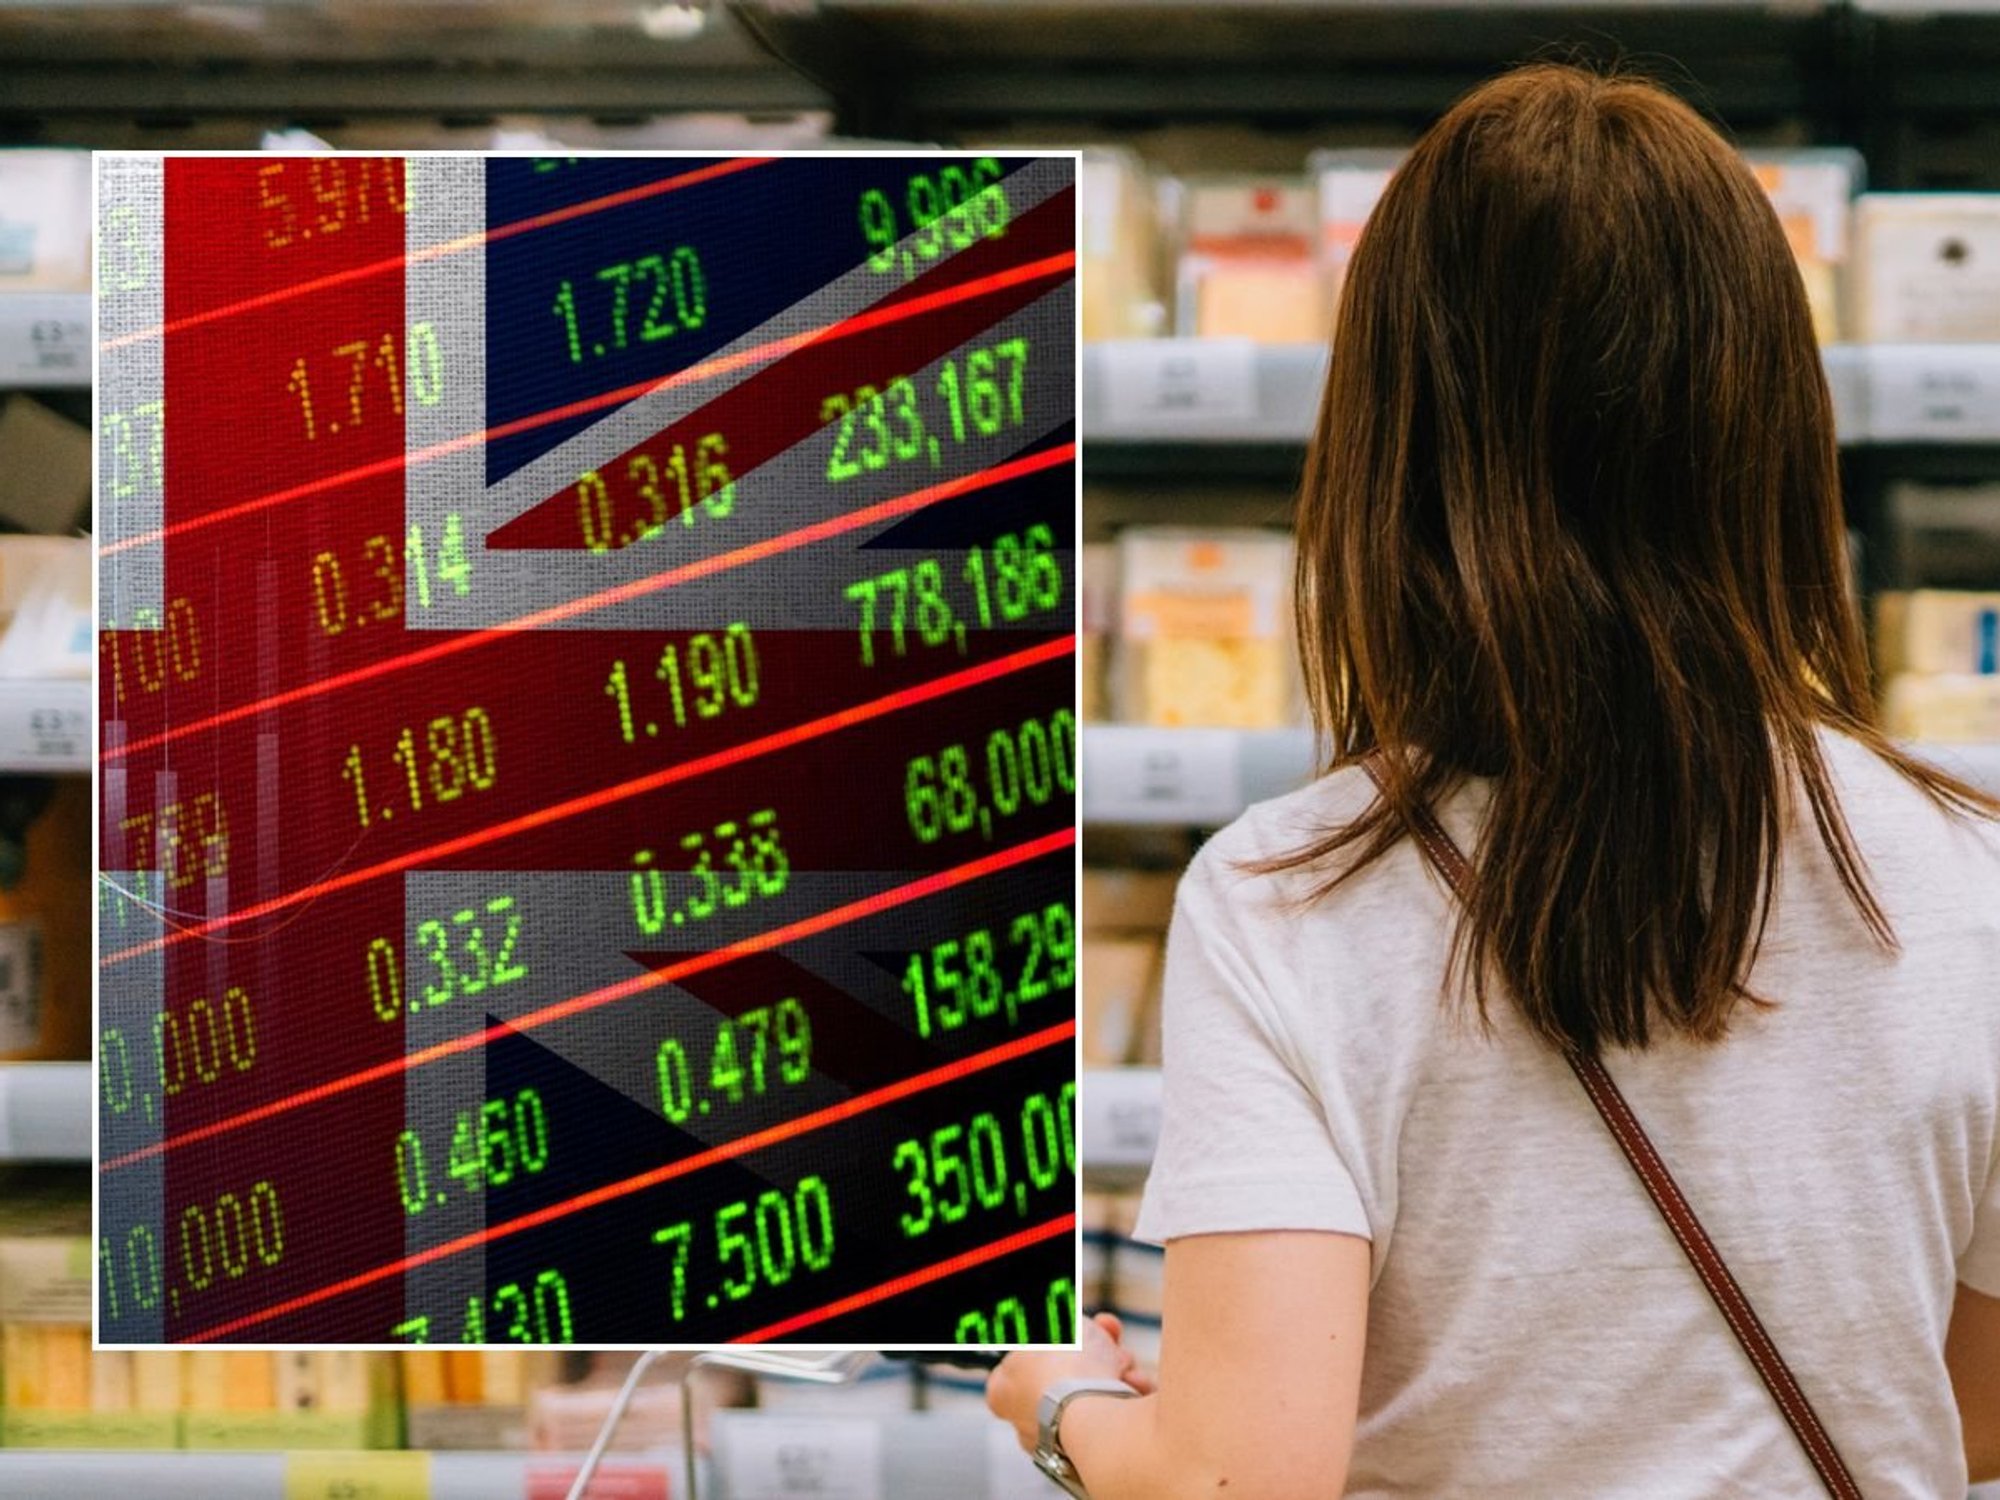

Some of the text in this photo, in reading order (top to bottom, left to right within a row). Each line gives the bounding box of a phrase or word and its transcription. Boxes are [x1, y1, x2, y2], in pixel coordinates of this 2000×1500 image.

[288, 322, 444, 440] 1.710
[554, 246, 707, 363] 1.720
[858, 158, 1011, 281] 9,996
[99, 598, 201, 702] 100
[313, 510, 476, 634] 0.314
[577, 433, 738, 555] 0.316
[821, 337, 1031, 482] 233,167
[341, 706, 497, 828] 1.180
[607, 620, 758, 742] 1.190
[842, 522, 1062, 668] 778,186
[98, 709, 1076, 1127] 0,000 0.332 0.338 68,000
[98, 1181, 284, 1320] 10,000
[396, 1088, 548, 1215] 0.460
[656, 999, 809, 1124] 0.479
[652, 1175, 834, 1321] 7.500
